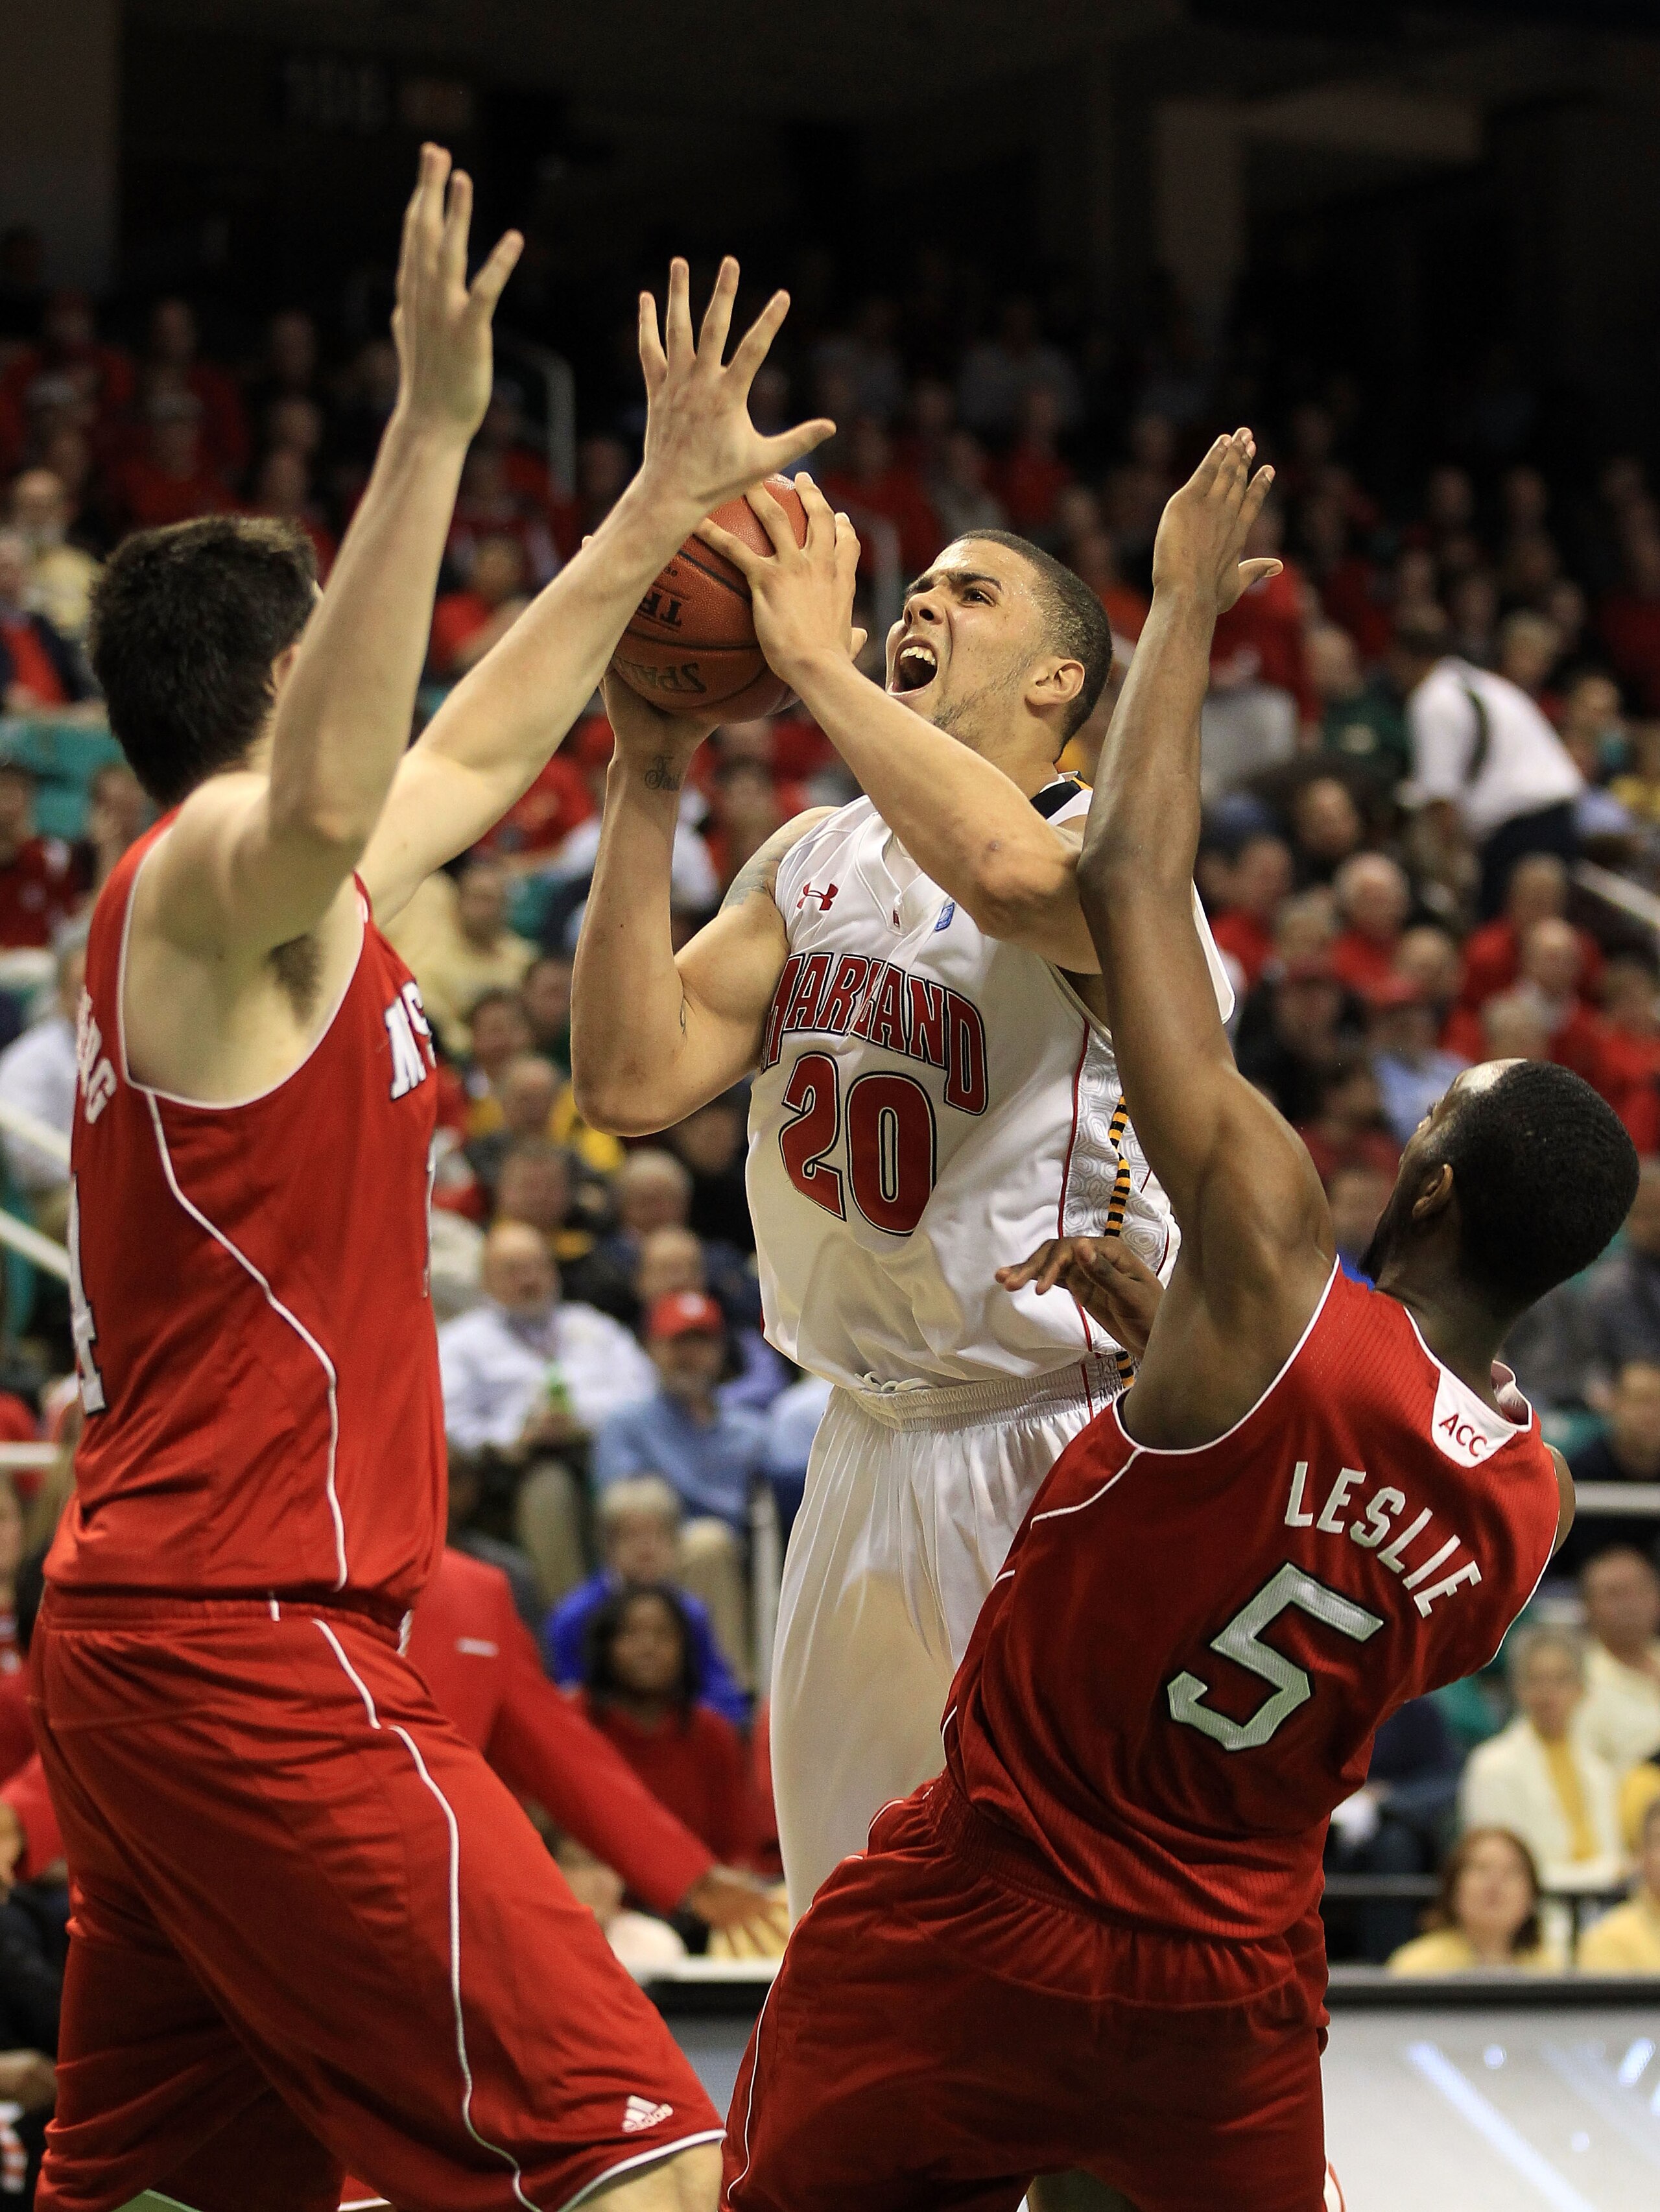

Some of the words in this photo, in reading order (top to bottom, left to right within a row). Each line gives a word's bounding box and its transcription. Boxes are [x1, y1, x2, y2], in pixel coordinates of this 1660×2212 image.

[778, 1051, 938, 1237] 20
[1438, 1413, 1488, 1458] ACC
[1284, 1460, 1482, 1619] LESLIE
[1167, 1561, 1385, 1752] 5
